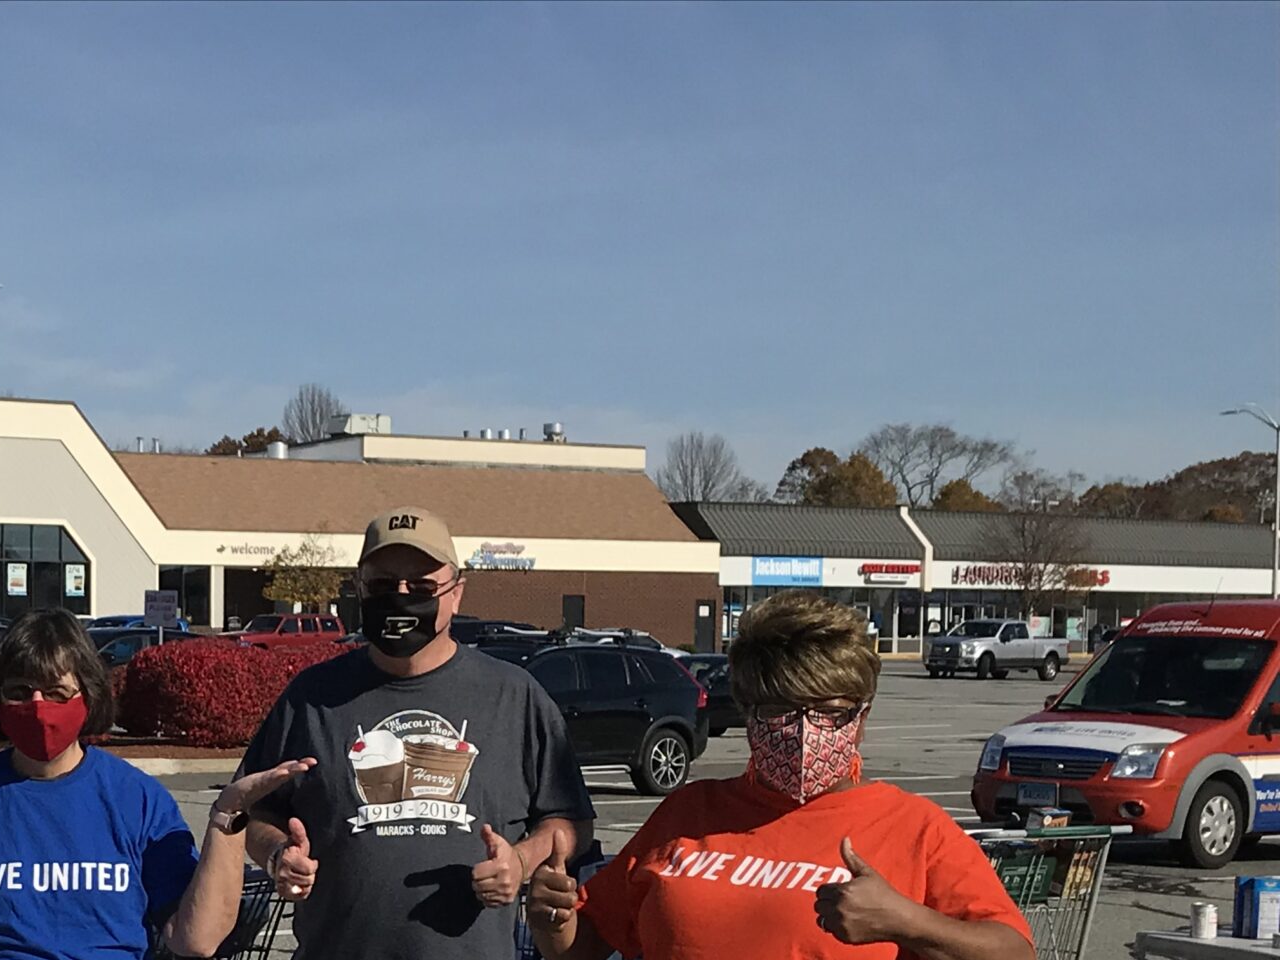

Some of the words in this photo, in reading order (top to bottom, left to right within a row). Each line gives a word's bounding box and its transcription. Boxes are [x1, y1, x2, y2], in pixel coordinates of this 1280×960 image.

[388, 514, 420, 531] CAT
[230, 541, 276, 555] welcome
[755, 558, 791, 576] Jackson
[792, 558, 820, 577] Hewitt
[385, 718, 401, 729] THE
[389, 719, 442, 734] CHOCOLATE
[430, 727, 454, 737] SHOP
[412, 767, 457, 788] Harry's
[363, 804, 404, 822] 1919
[419, 801, 461, 819] 2019
[376, 825, 415, 837] MARACKS
[420, 824, 447, 836] COOKS
[658, 846, 737, 881] LIVE
[32, 862, 130, 892] UNITED
